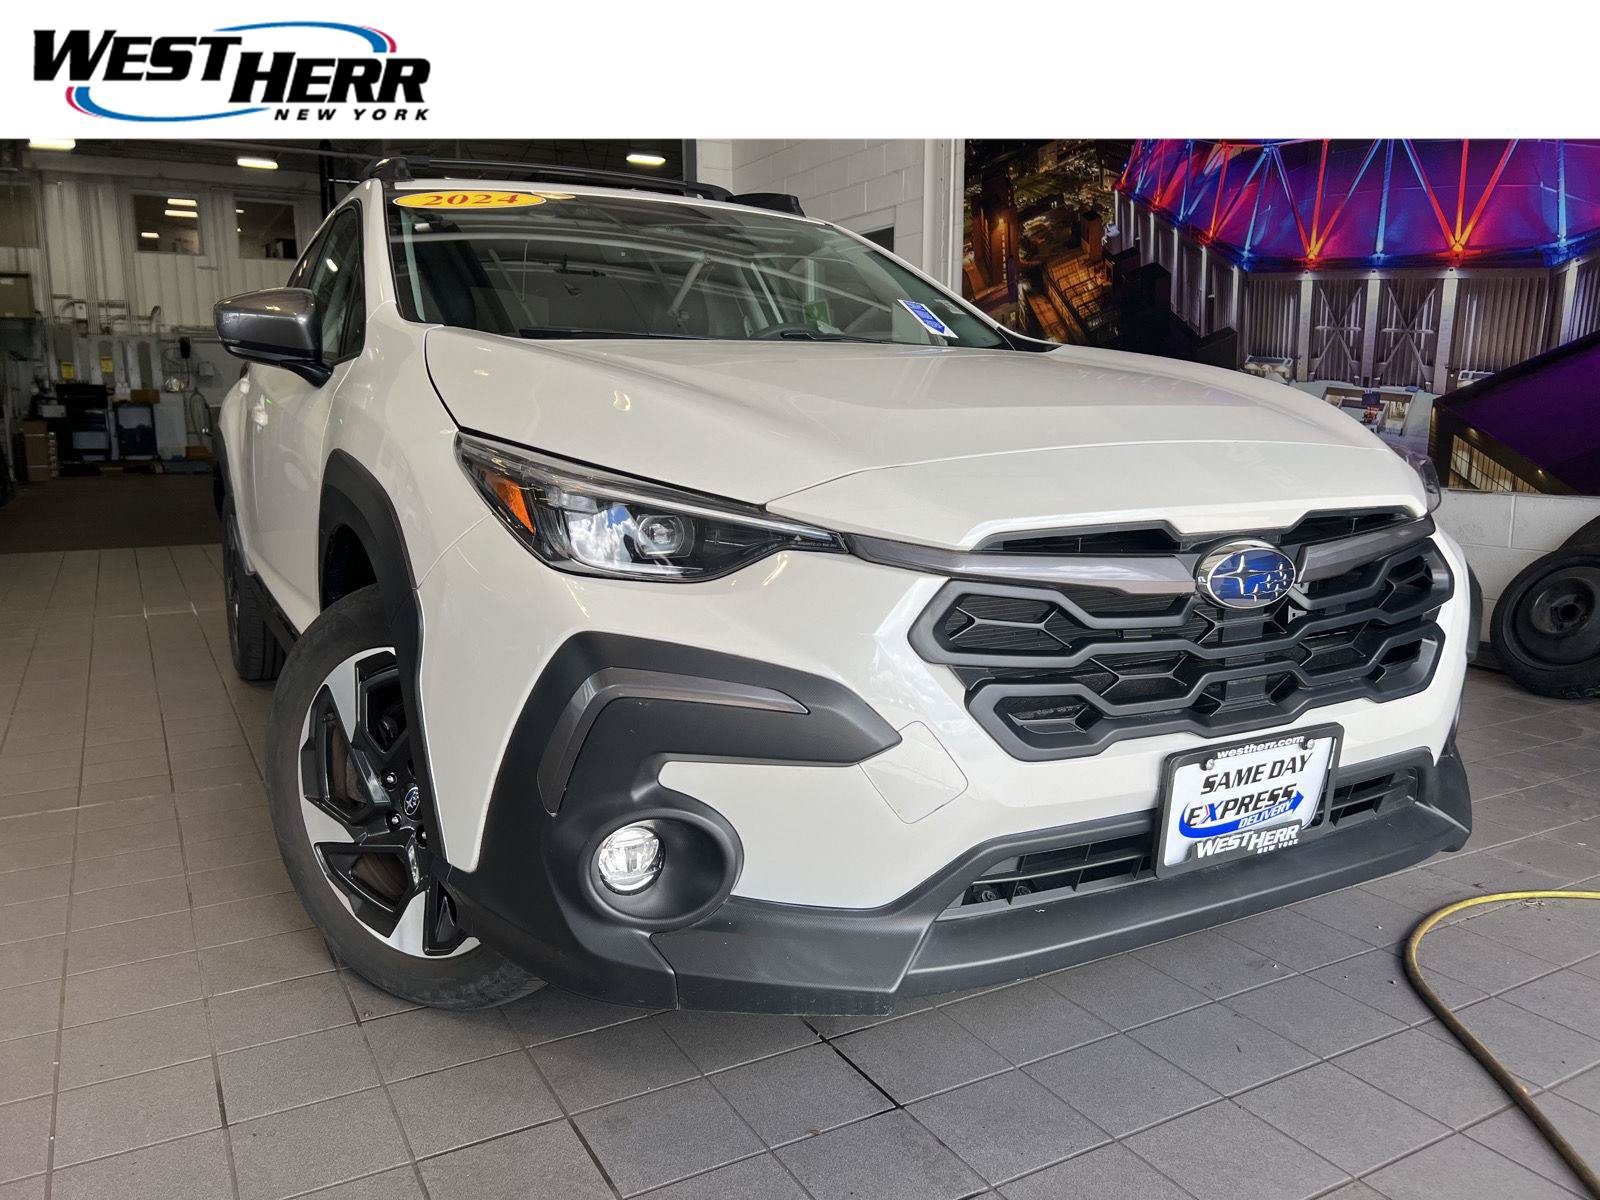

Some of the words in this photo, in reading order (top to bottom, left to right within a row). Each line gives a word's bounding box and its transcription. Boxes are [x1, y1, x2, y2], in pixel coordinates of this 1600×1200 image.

[424, 194, 519, 207] 2024
[1217, 736, 1304, 759] westherr.com
[1200, 763, 1266, 795] SAME
[1268, 753, 1312, 779] DAY
[1187, 783, 1297, 827] EXPRESS
[1238, 801, 1292, 828] DELIVERY
